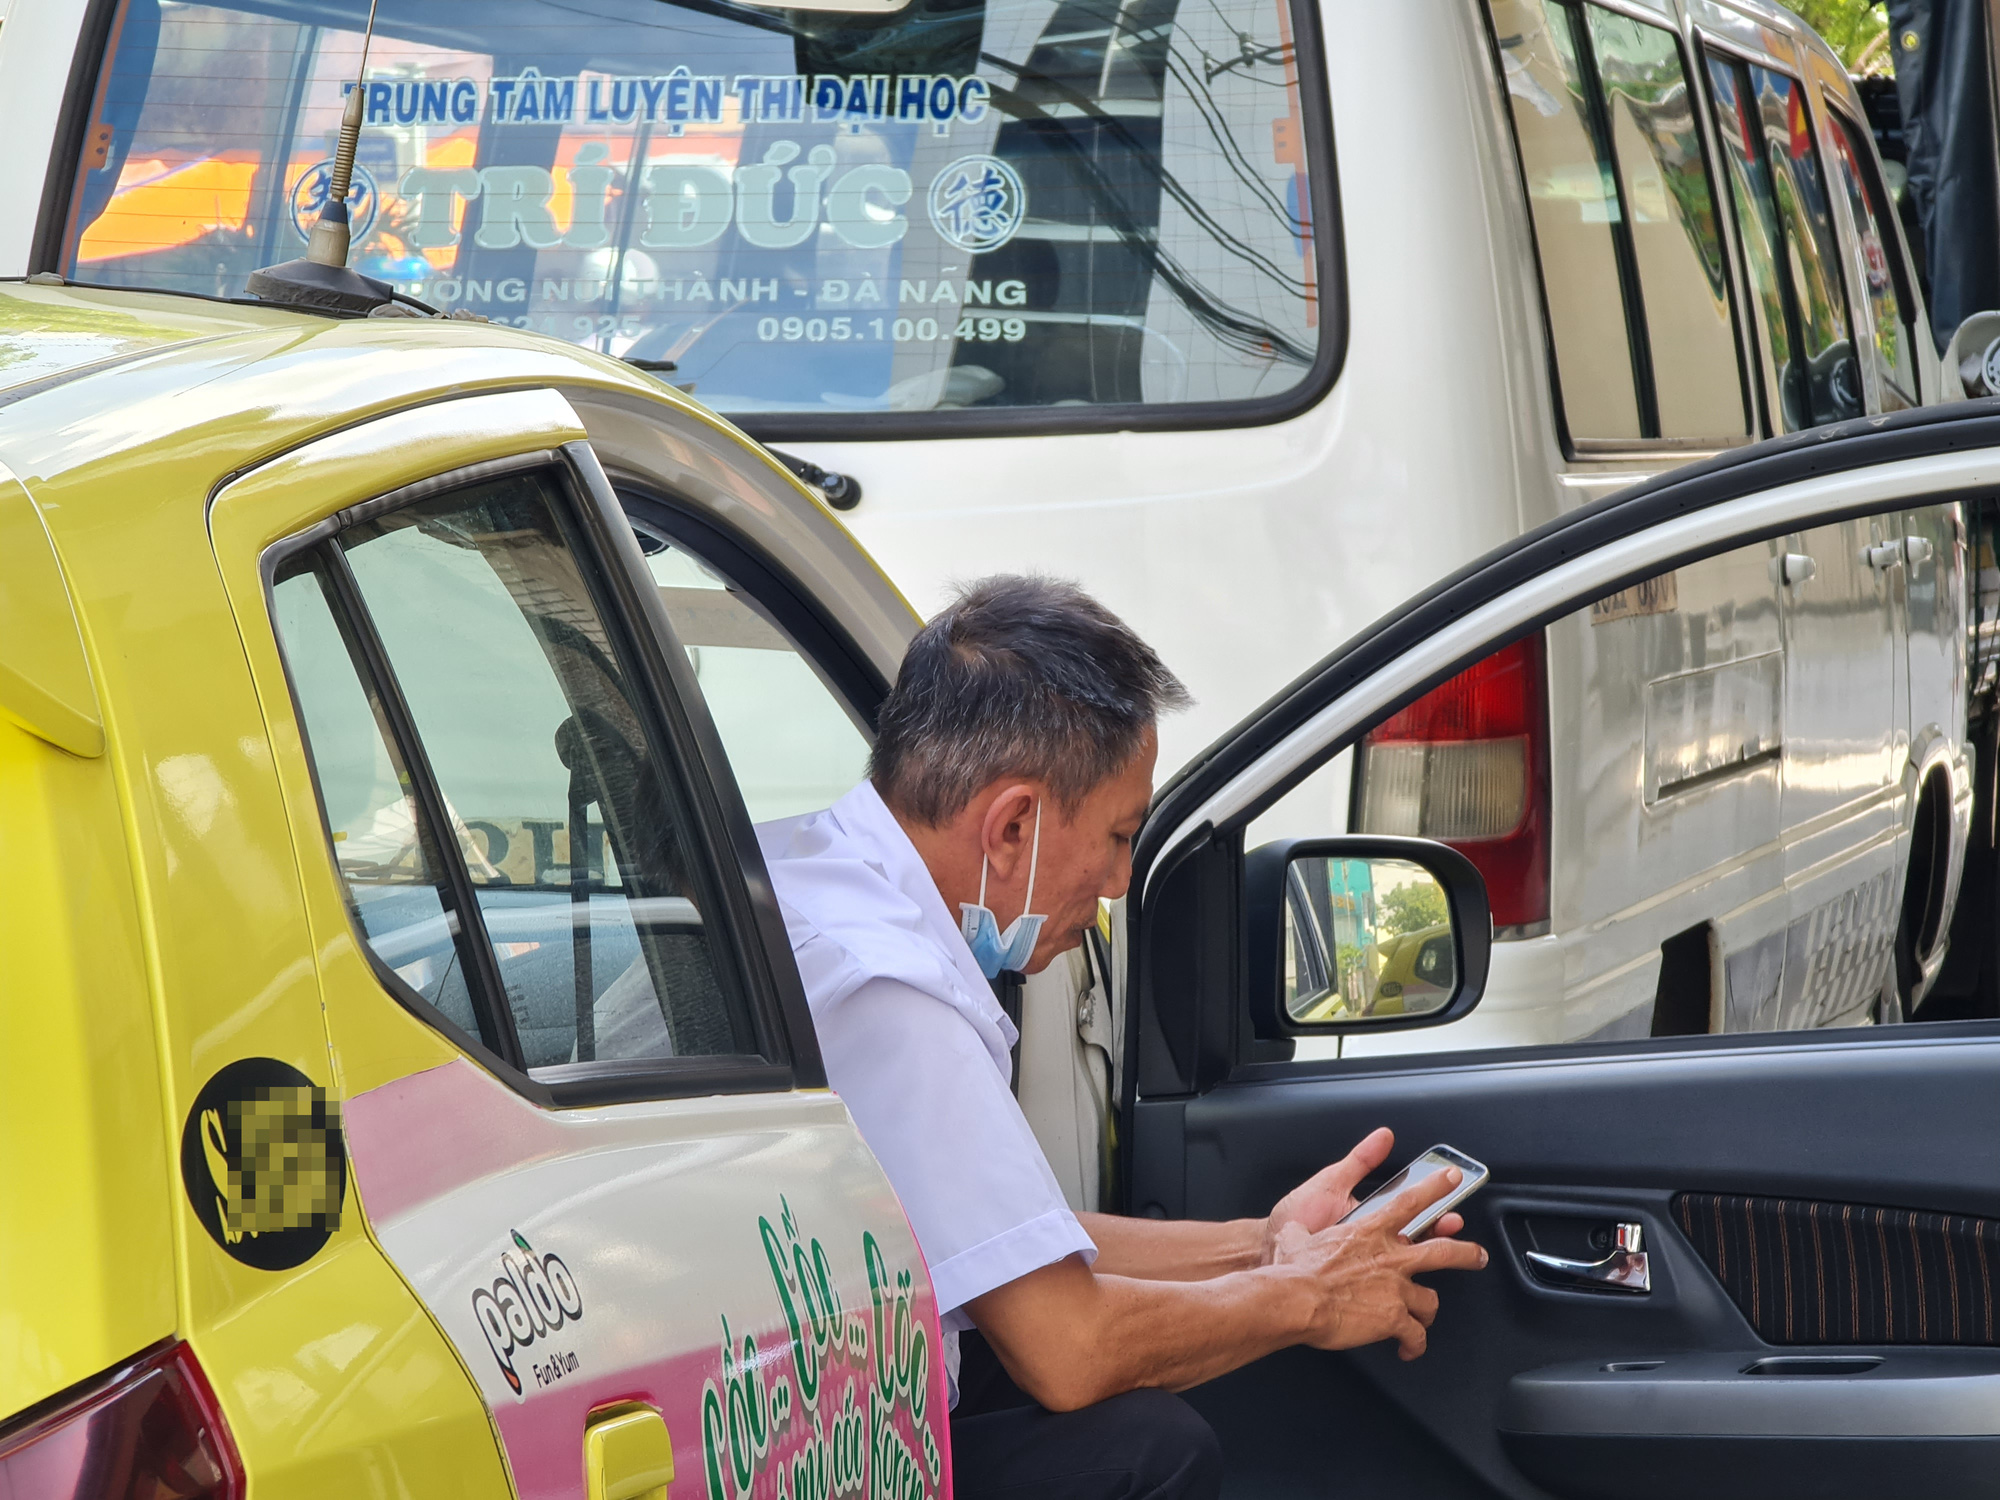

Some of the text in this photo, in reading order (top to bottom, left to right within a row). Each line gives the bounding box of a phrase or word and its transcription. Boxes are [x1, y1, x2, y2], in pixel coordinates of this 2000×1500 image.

[490, 66, 575, 124] TÂM
[587, 65, 725, 137] LUYỆN
[732, 75, 807, 124] THI
[810, 74, 890, 136] ĐẠI
[894, 74, 991, 137] HỌC
[401, 141, 614, 249] TRÍ
[639, 140, 913, 249] ĐỨC
[391, 269, 526, 302] ƯỜNG
[822, 271, 881, 302] ĐÀ
[758, 317, 1027, 342] 0905.100.499
[471, 1229, 582, 1395] paldo
[533, 1351, 580, 1388] Fun&Yum
